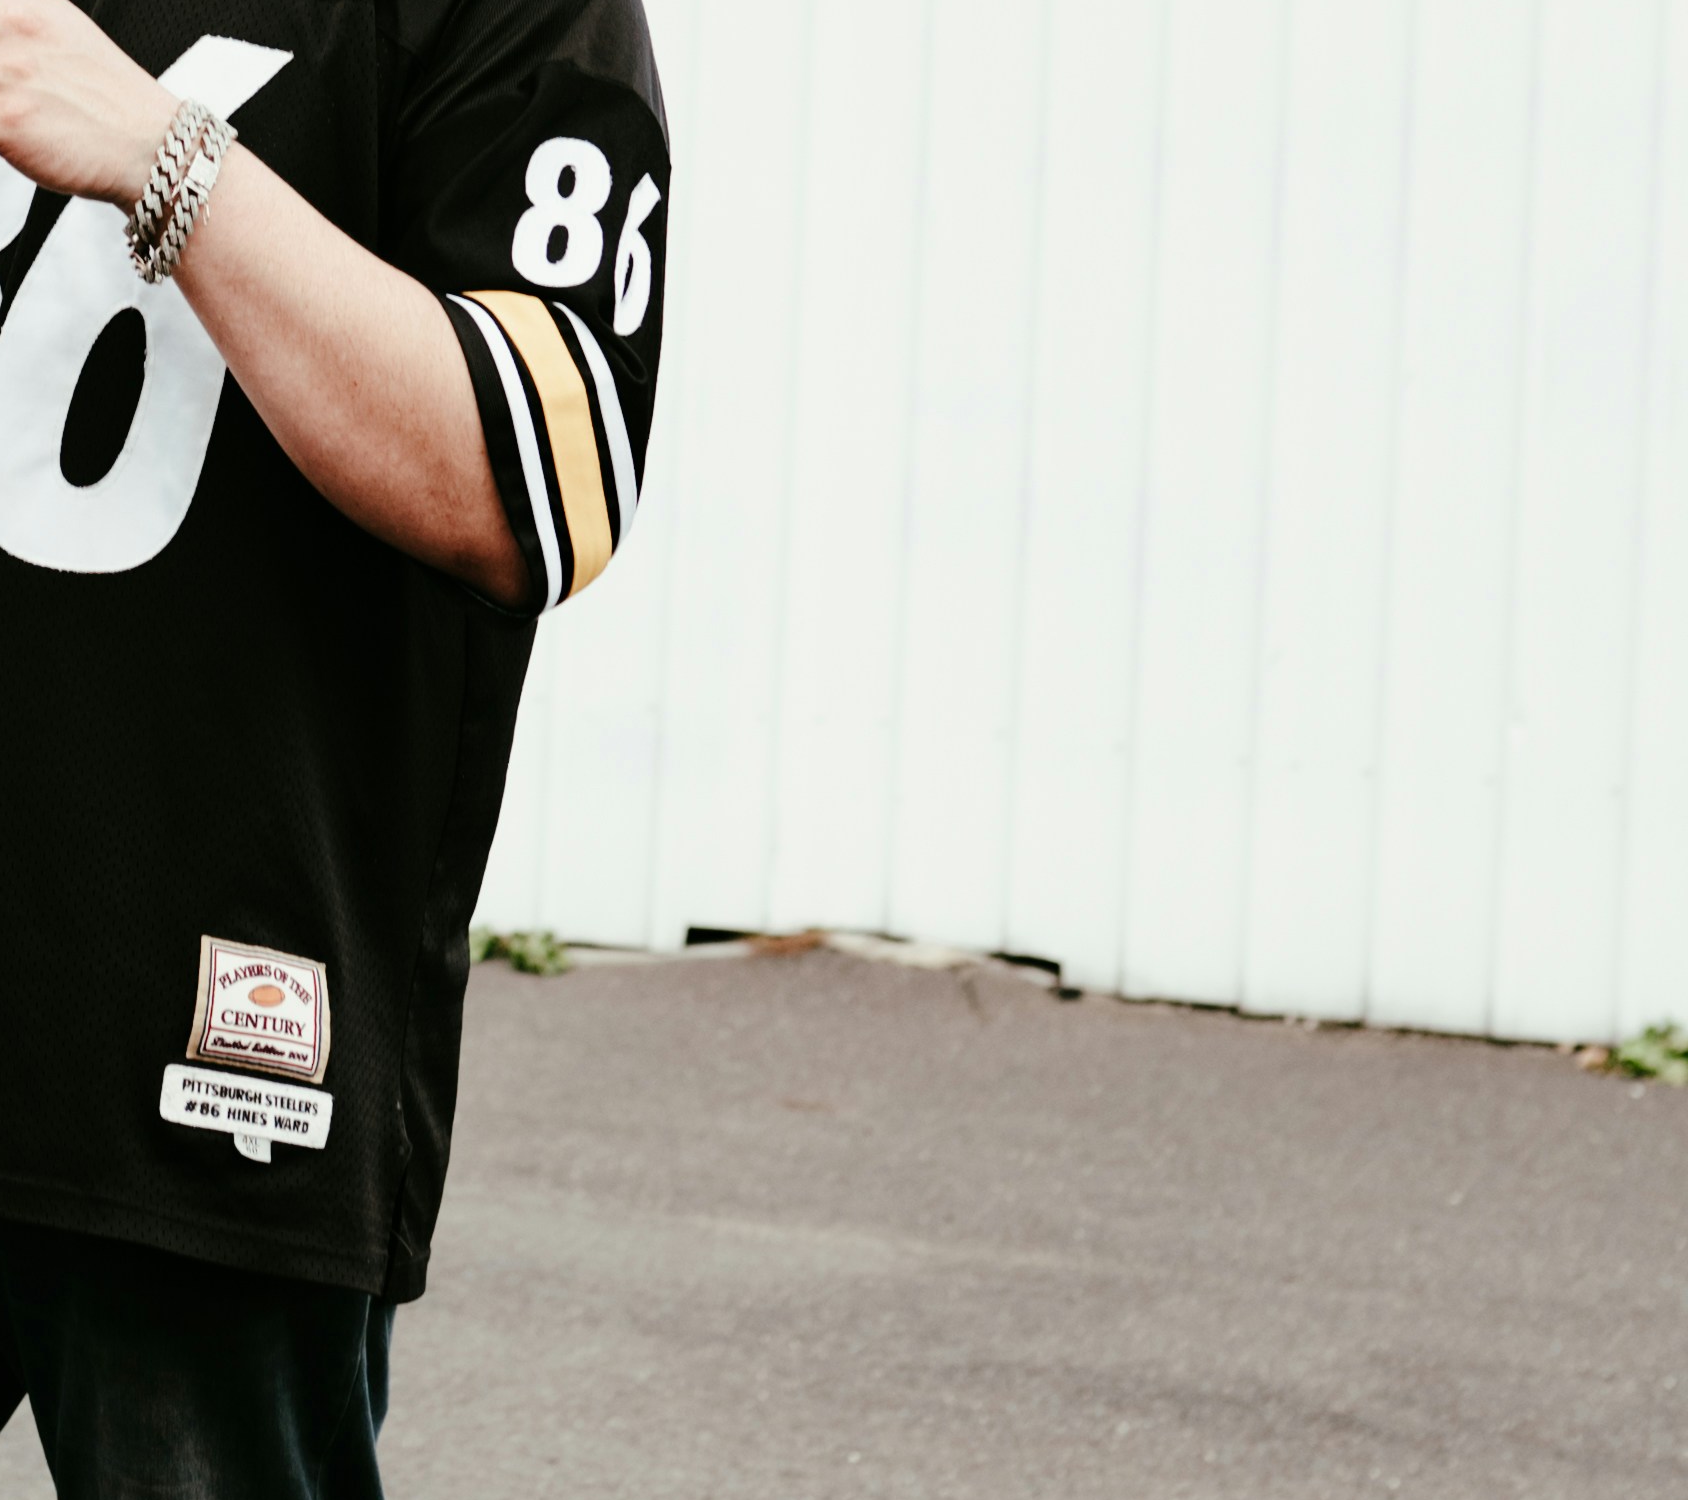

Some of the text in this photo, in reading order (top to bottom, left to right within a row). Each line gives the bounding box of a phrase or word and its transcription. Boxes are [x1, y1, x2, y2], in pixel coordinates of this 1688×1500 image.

[511, 135, 662, 338] 86
[218, 963, 313, 1006] PLAYERS OF THE
[220, 1008, 307, 1038] CENTURY
[182, 1078, 319, 1117] PITTSBURGH STEELERS
[226, 1106, 268, 1127] HINES
[273, 1114, 310, 1135] WARD
